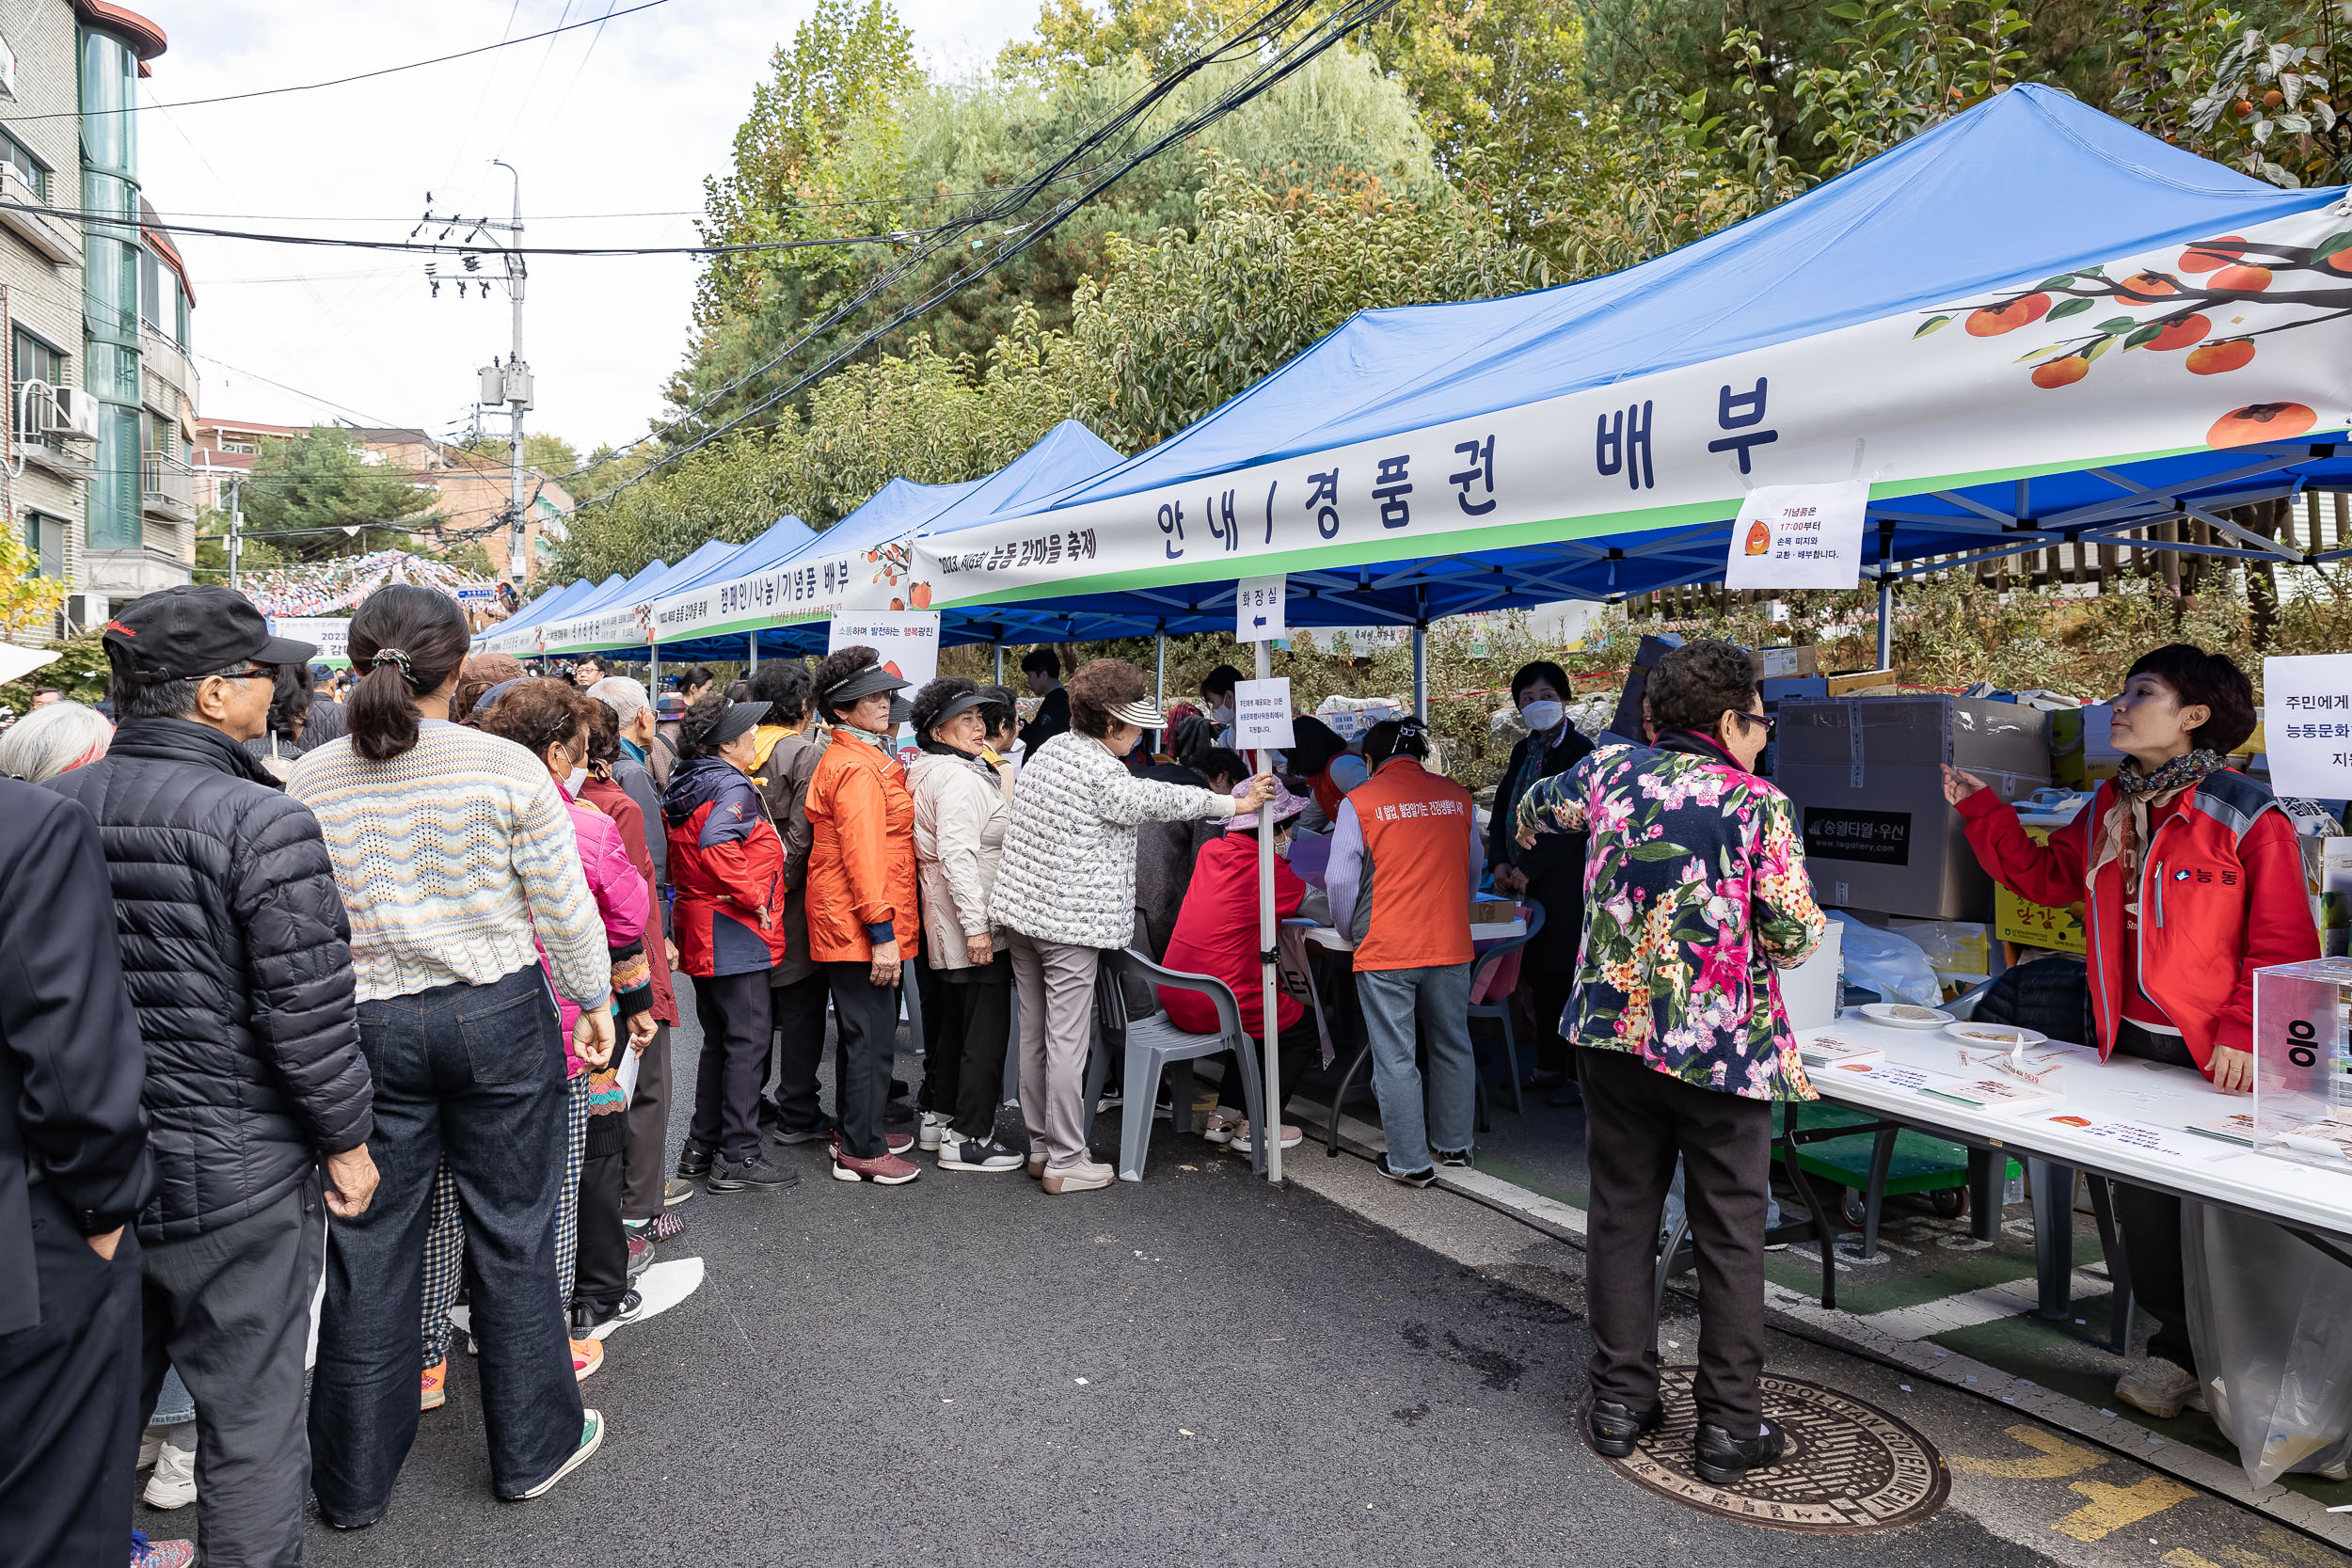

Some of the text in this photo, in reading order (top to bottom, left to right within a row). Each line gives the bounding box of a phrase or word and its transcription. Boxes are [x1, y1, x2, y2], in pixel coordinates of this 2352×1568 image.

[1157, 376, 1780, 560] 안내/경품권 배부
[1783, 507, 1817, 517] 기념품은
[1780, 521, 1821, 531] 17:00부터
[1777, 536, 1818, 546] 손목 띠지와
[939, 556, 961, 575] 2023.
[987, 542, 1017, 571] 능동
[1017, 533, 1062, 567] 감마을
[1067, 528, 1097, 562] 축제
[1775, 550, 1790, 560] 교환
[1797, 549, 1839, 560] 배부합니다.
[721, 560, 849, 614] 캠페인/나눔/기념품 배부
[1242, 587, 1277, 608] 화장실
[838, 626, 933, 637] 소통하며 발전하는 행복광진
[2285, 694, 2349, 710] 주민에게
[2285, 723, 2352, 738] 능동문화
[1375, 806, 1384, 821] 내
[1383, 804, 1400, 821] 혈압,
[1398, 801, 1429, 818] 혈당알기는
[1823, 820, 1904, 841] 송월타월·우산
[2196, 869, 2237, 886] 능동
[2016, 907, 2057, 930] 단감
